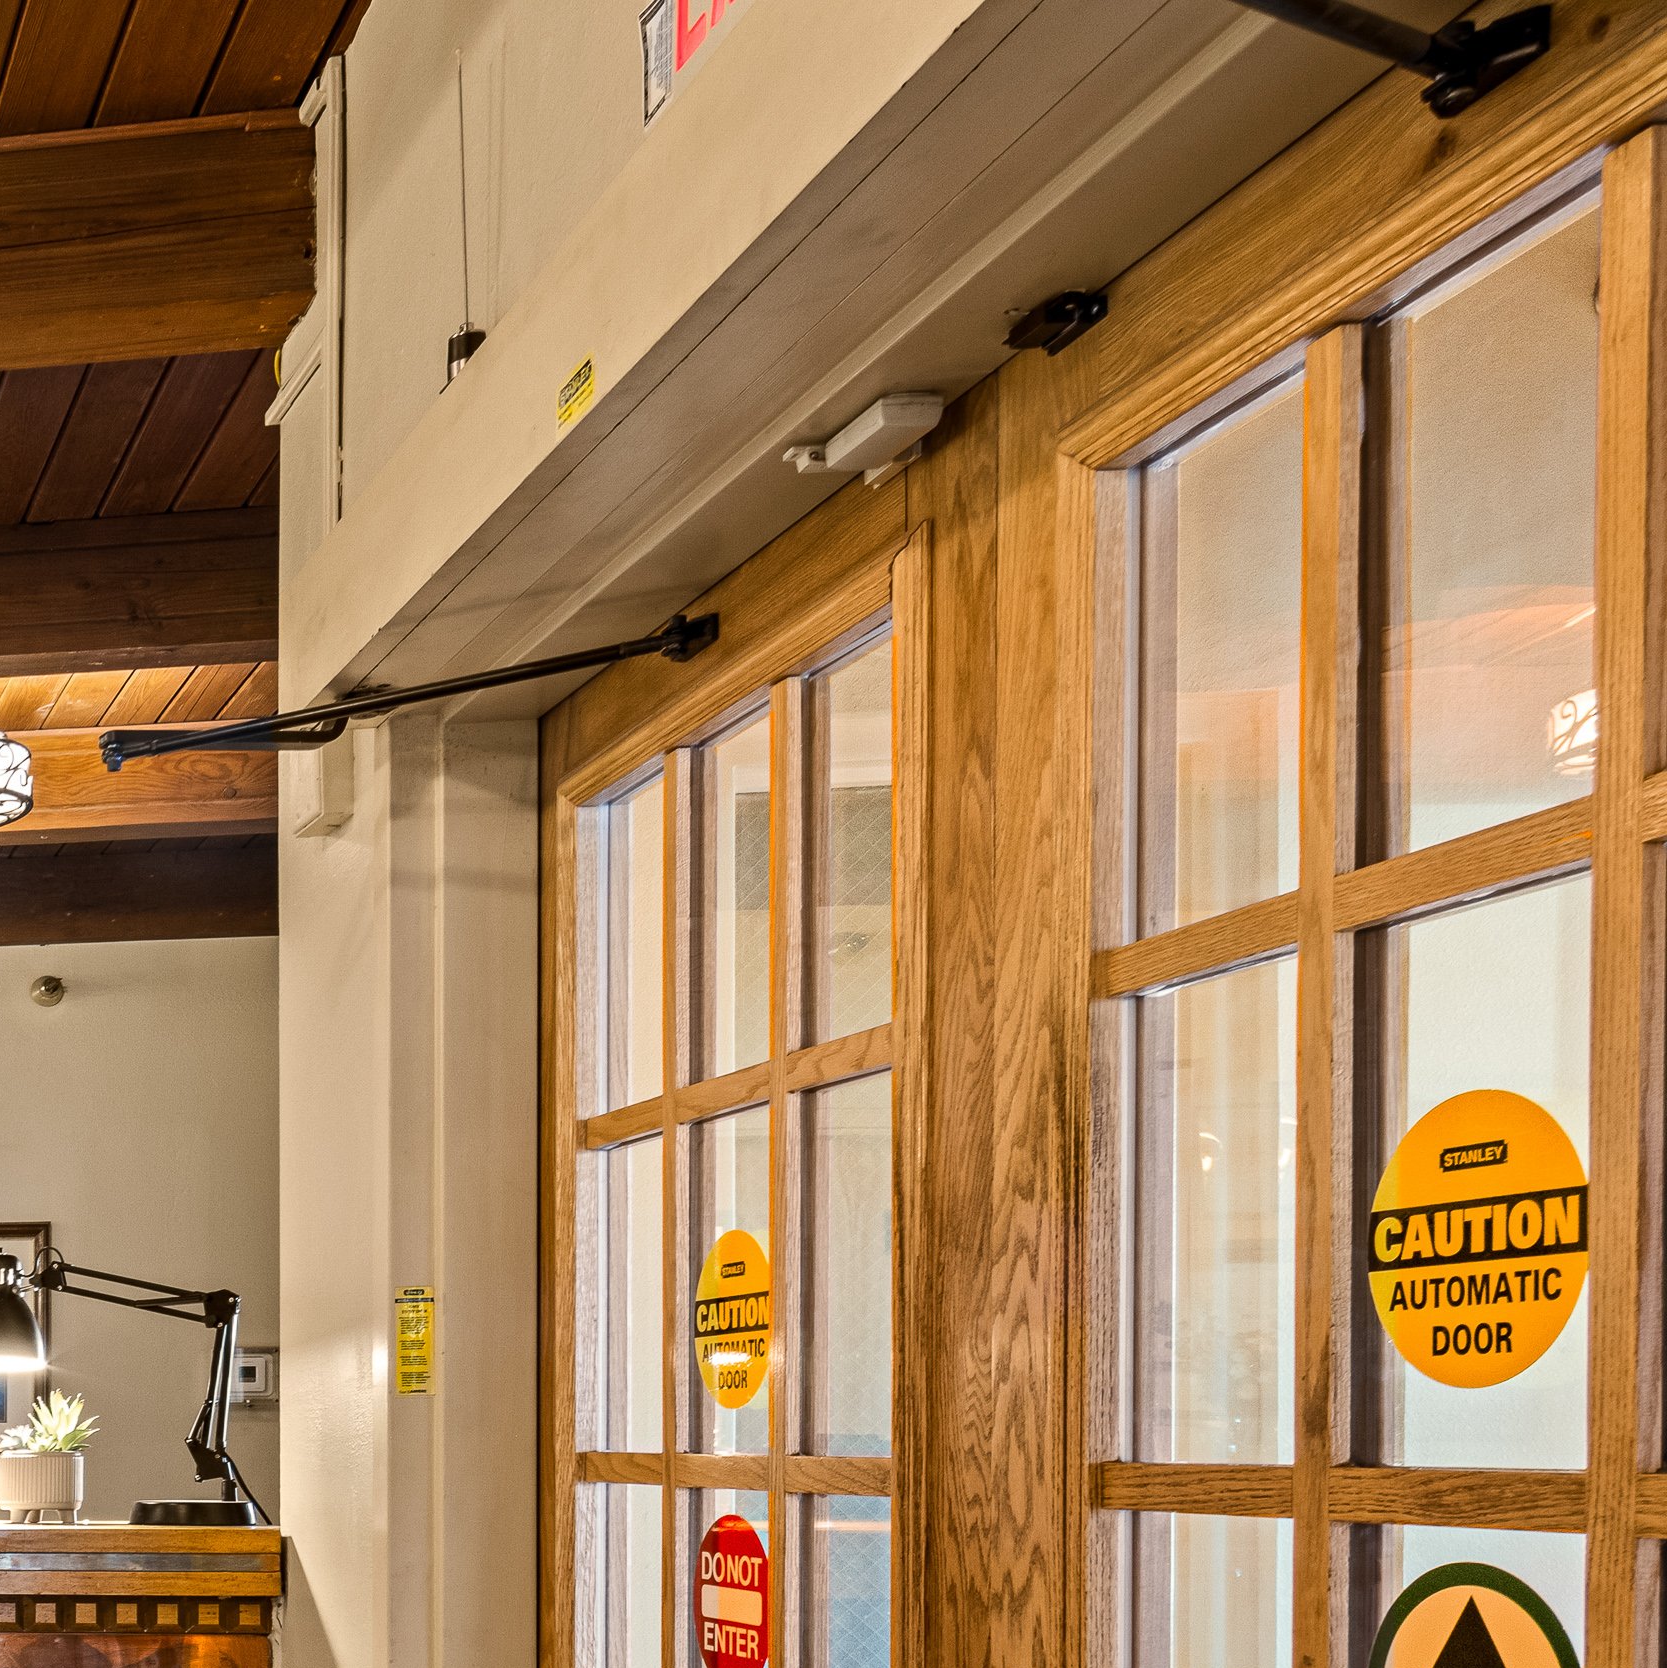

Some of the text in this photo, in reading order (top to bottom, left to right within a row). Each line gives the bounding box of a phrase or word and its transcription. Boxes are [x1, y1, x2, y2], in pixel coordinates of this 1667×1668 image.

[1444, 1146, 1503, 1168] STANLEY
[1374, 1195, 1579, 1262] CAUTION
[1389, 1268, 1562, 1311] AUTOMATIC
[697, 1298, 769, 1332] CAUTION
[1432, 1322, 1513, 1356] DOOR
[719, 1370, 747, 1390] DOOR
[702, 1552, 762, 1587] DO NOT
[704, 1621, 759, 1660] ENTER
